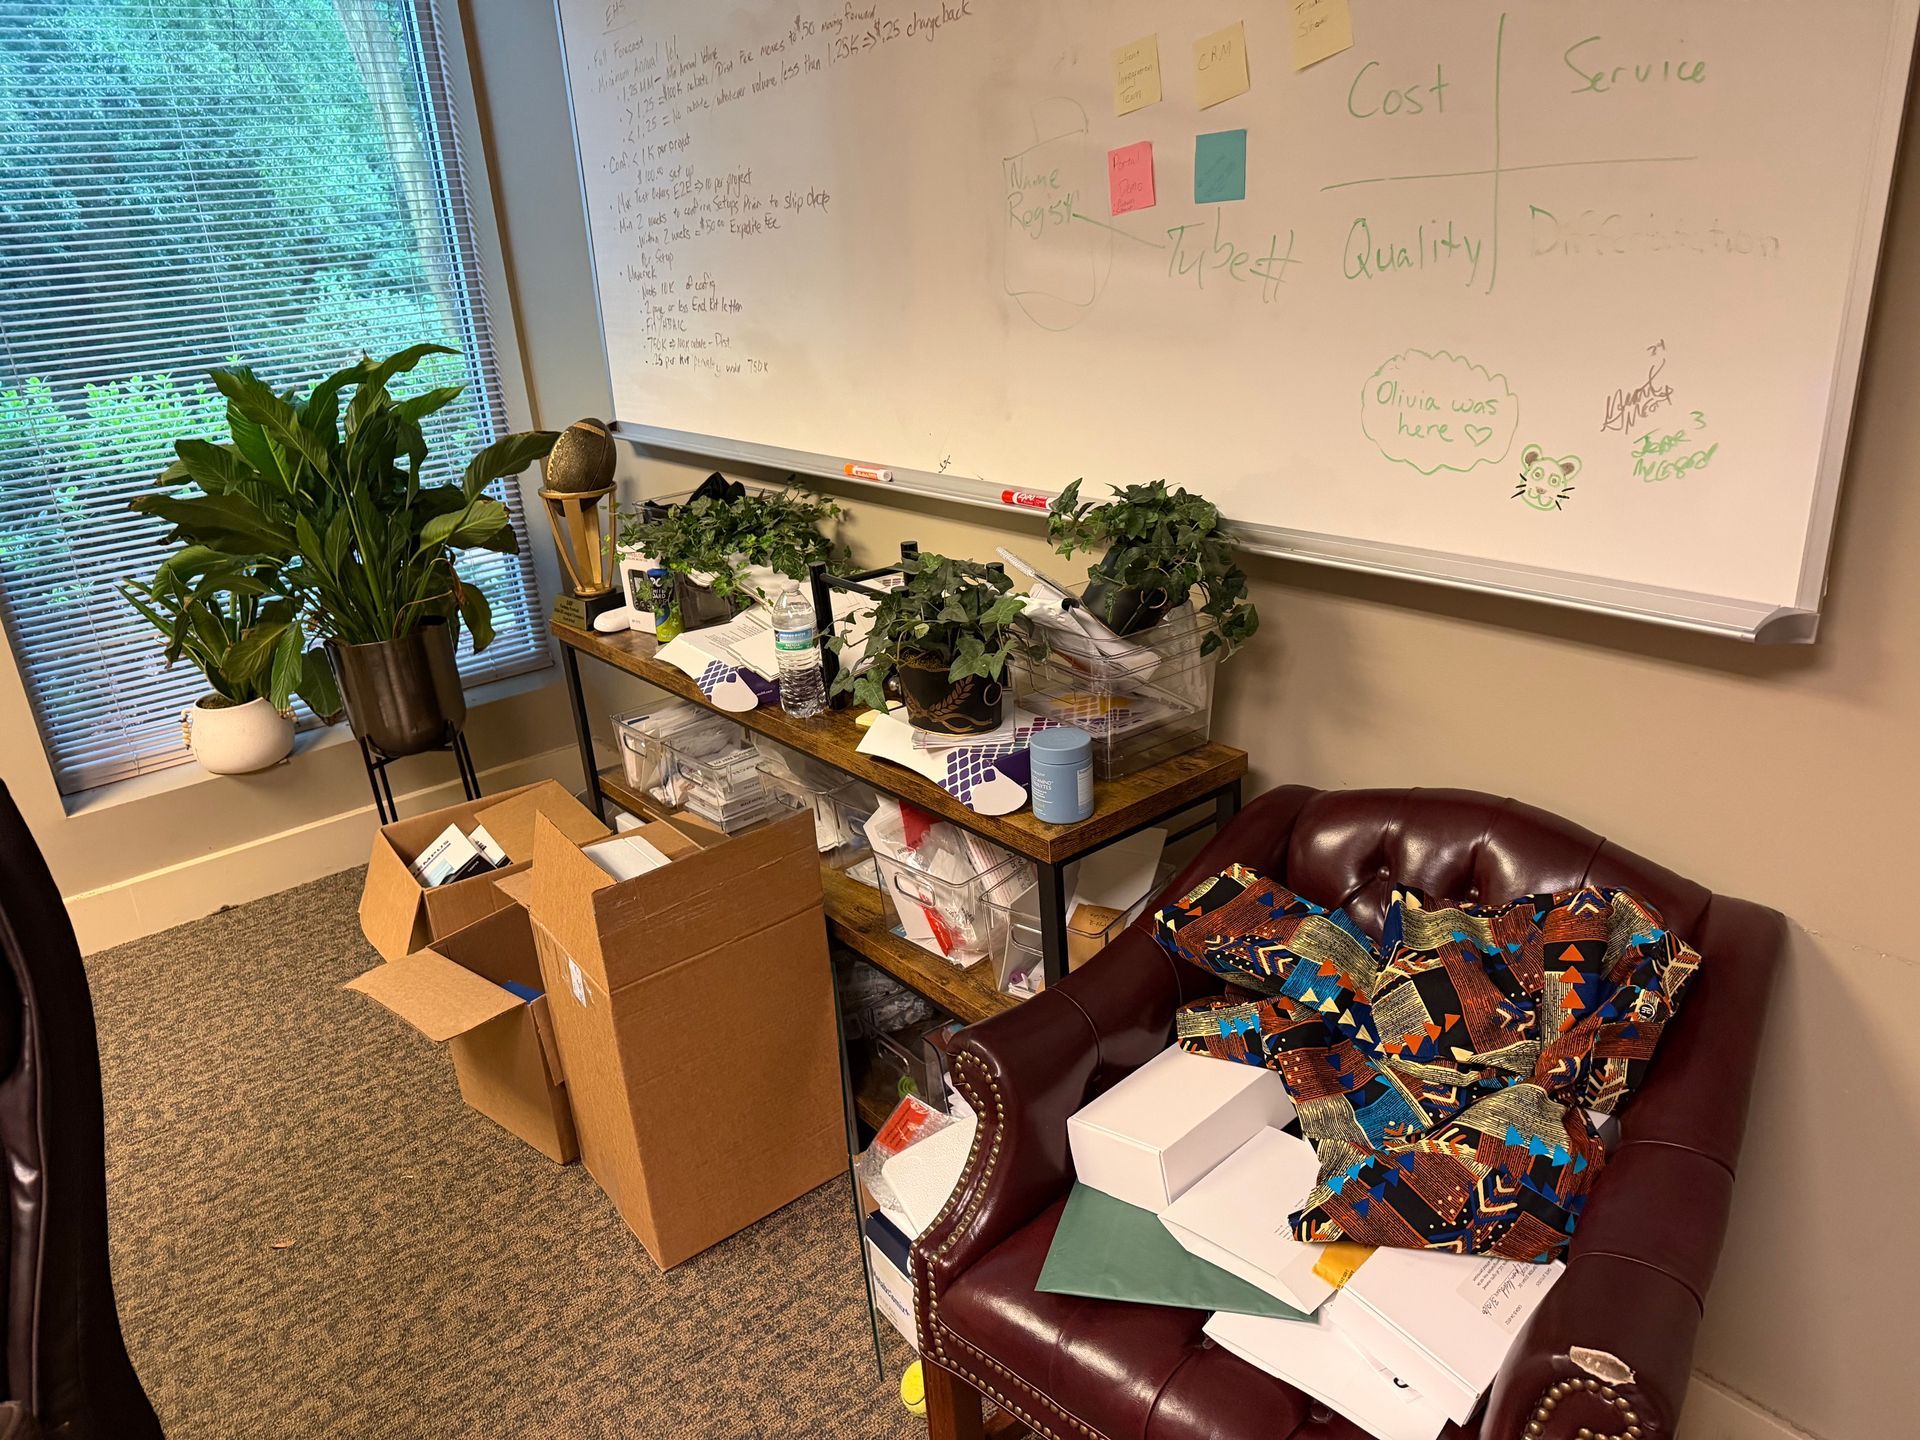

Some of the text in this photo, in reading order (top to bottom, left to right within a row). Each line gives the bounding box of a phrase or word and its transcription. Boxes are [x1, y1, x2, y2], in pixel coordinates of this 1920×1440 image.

[760, 39, 785, 56] moves
[1198, 39, 1232, 71] CRM
[1564, 36, 1707, 93] Service
[780, 60, 800, 85] less
[804, 53, 821, 74] than
[1348, 61, 1449, 118] Cost
[726, 164, 752, 199] project
[1343, 217, 1482, 288] Quality
[1377, 380, 1500, 416] Olivia was
[1398, 411, 1455, 443] here
